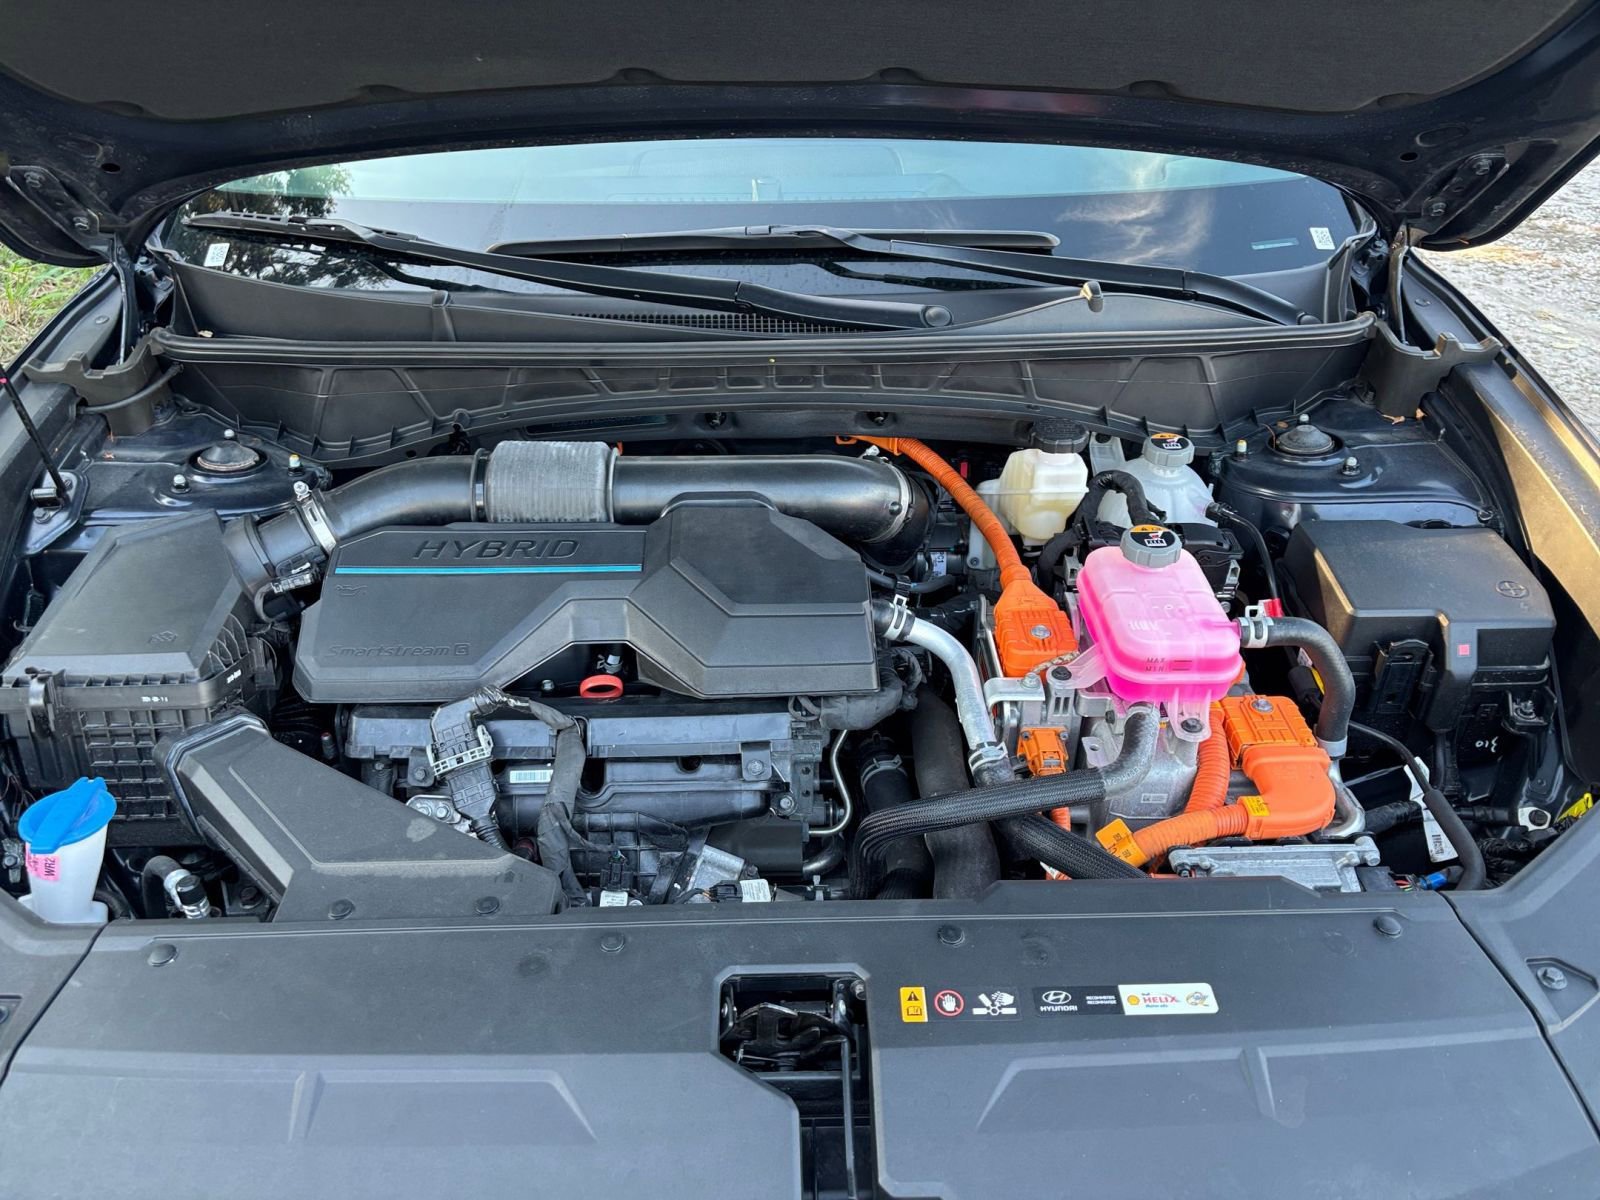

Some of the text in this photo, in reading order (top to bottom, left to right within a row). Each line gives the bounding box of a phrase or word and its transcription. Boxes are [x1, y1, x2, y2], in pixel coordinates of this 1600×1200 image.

[412, 540, 580, 560] HYBRID
[325, 644, 451, 658] Smartstream
[44, 858, 55, 876] WR2
